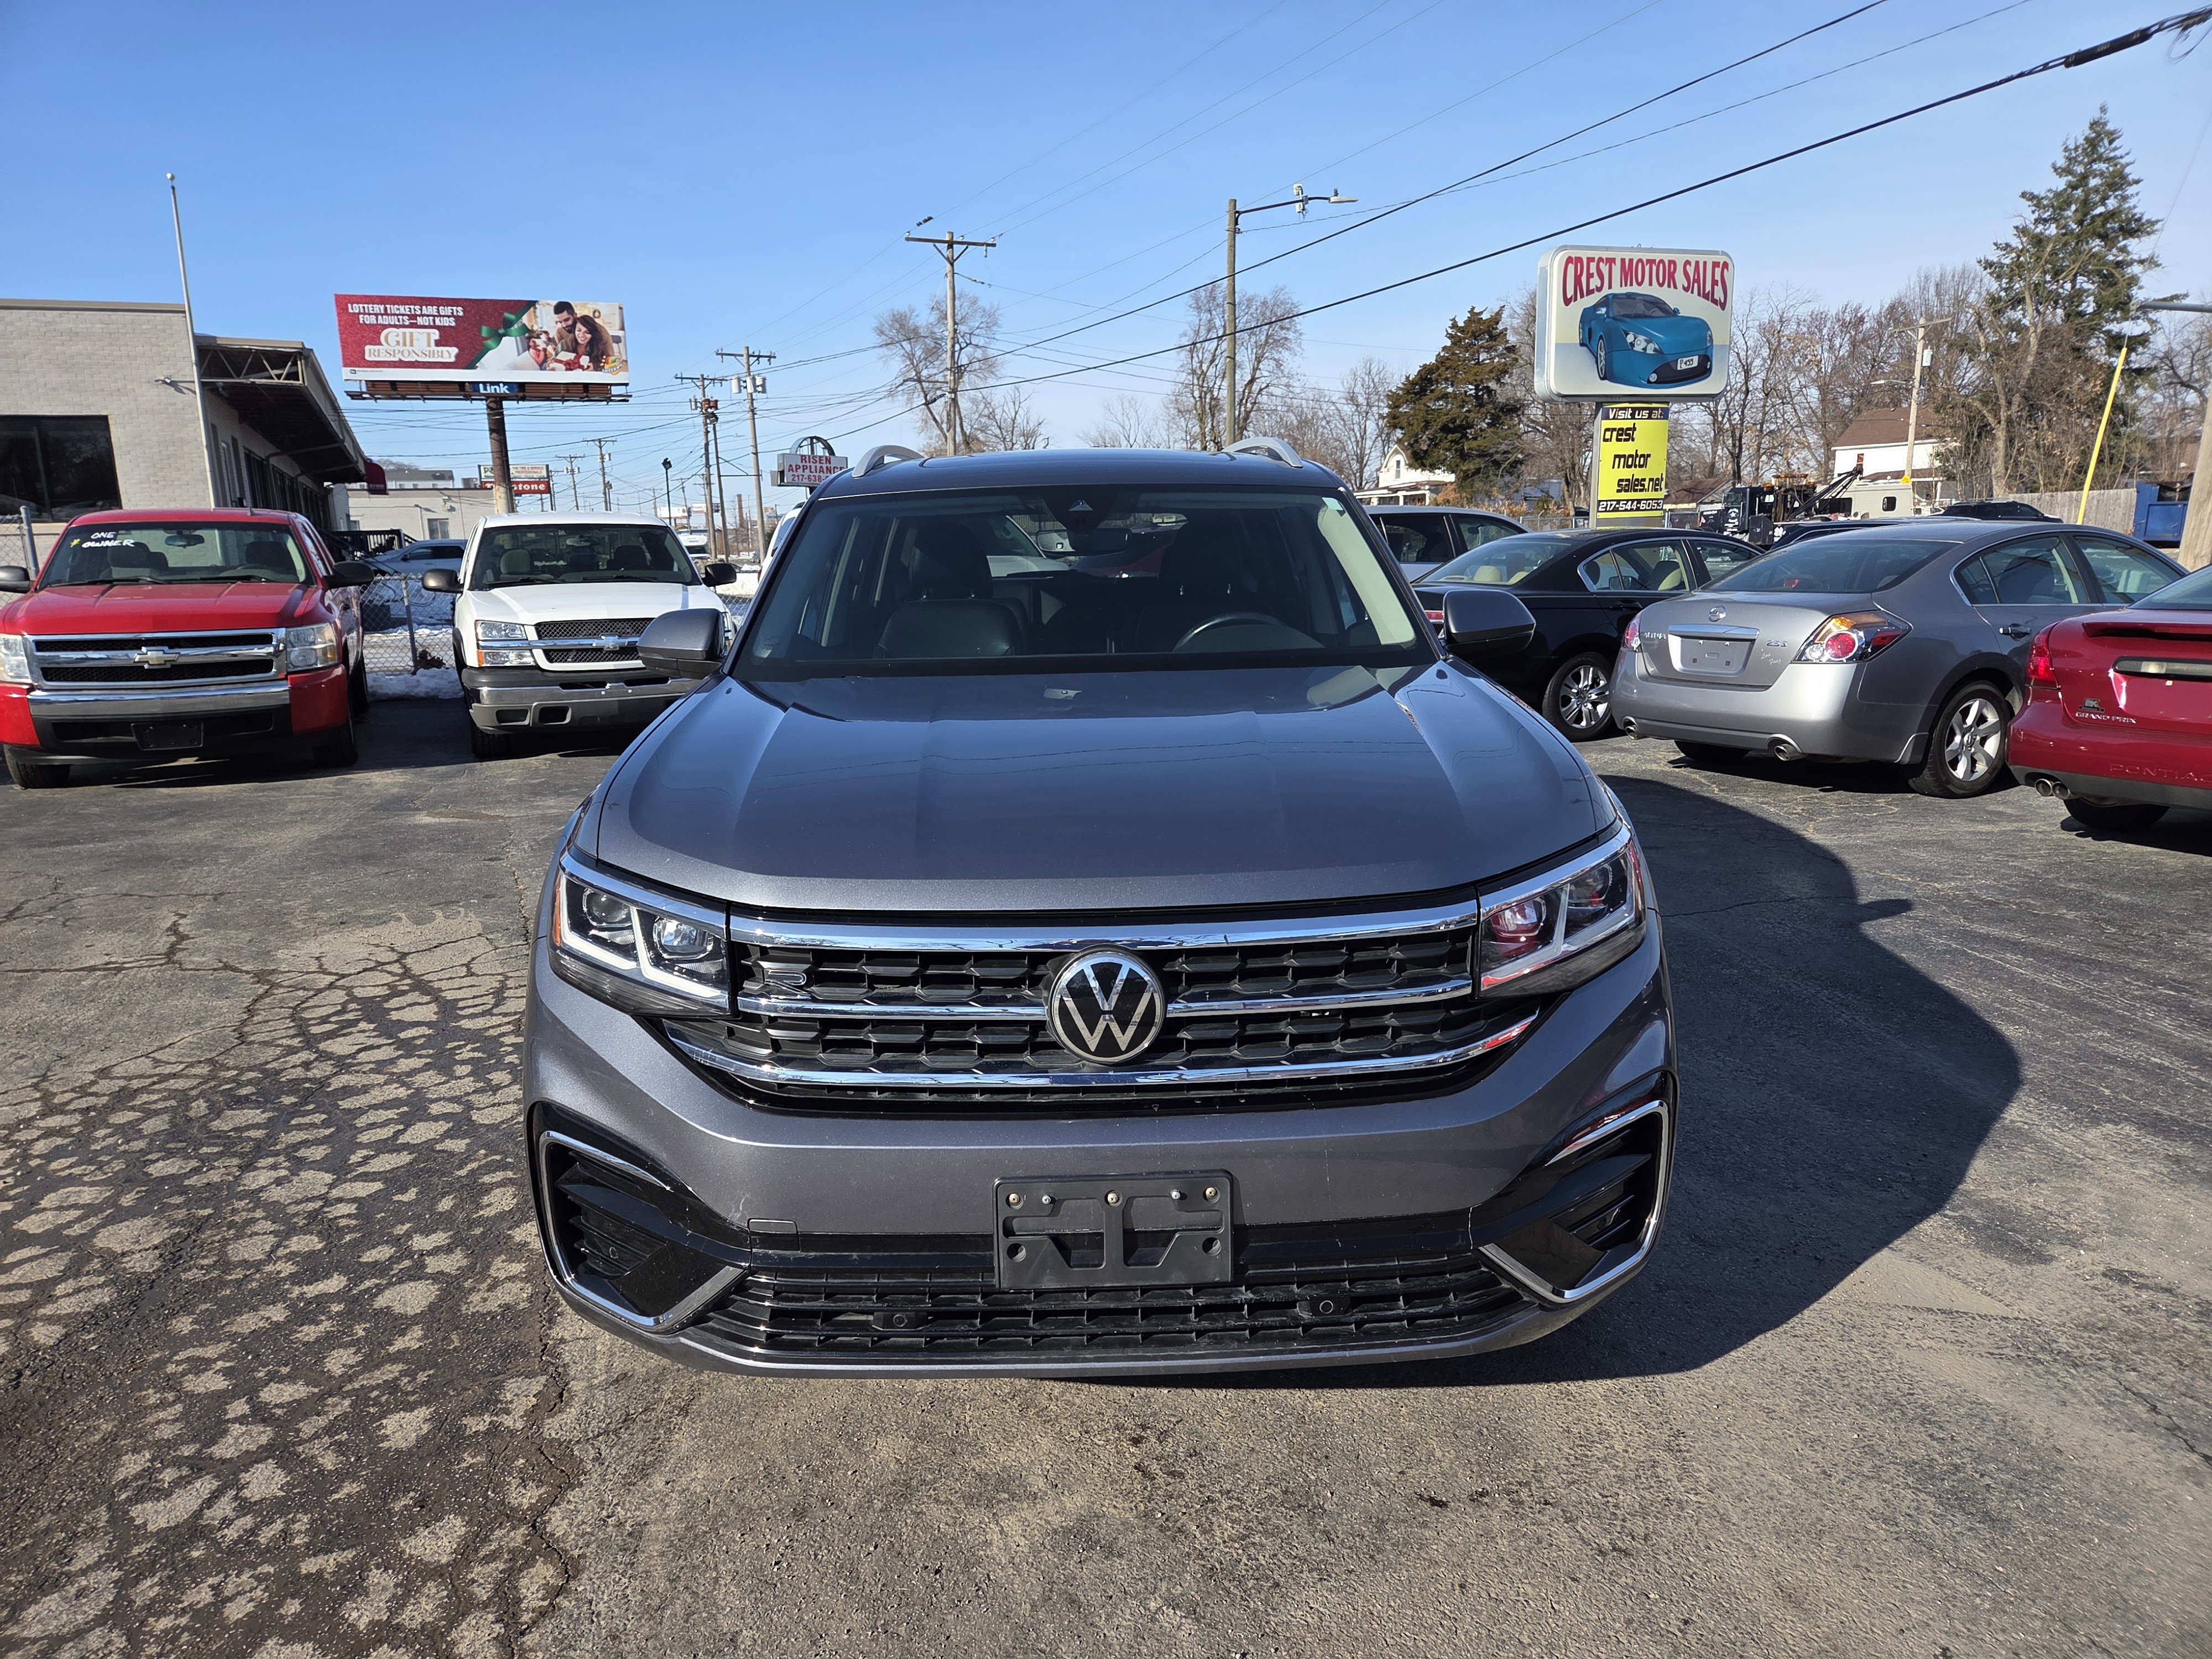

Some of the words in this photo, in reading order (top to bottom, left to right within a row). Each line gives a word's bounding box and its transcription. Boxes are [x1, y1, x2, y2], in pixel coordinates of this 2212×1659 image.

[1562, 255, 1616, 307] CREST
[1620, 258, 1678, 290] MOTOR
[1682, 259, 1729, 311] SALES
[347, 304, 384, 314] LOTTERY
[385, 305, 421, 315] TICKETS
[422, 305, 439, 315] ARE
[439, 306, 464, 316] GIFTS
[359, 315, 377, 324] FOR
[435, 317, 456, 326] KIDS
[384, 331, 436, 347] GIFT
[368, 348, 456, 359] RESPONSIBLY
[479, 383, 509, 394] Link
[1609, 408, 1632, 419] Visit
[1635, 410, 1649, 419] us
[1651, 408, 1664, 419] at:
[1603, 422, 1636, 442] crest
[800, 455, 832, 465] RISEN
[1611, 449, 1651, 469] motor
[1616, 473, 1663, 493] sales.net
[1598, 500, 1663, 511] 217-544-6053
[81, 539, 135, 548] OWNER
[2075, 712, 2110, 720] GRAND
